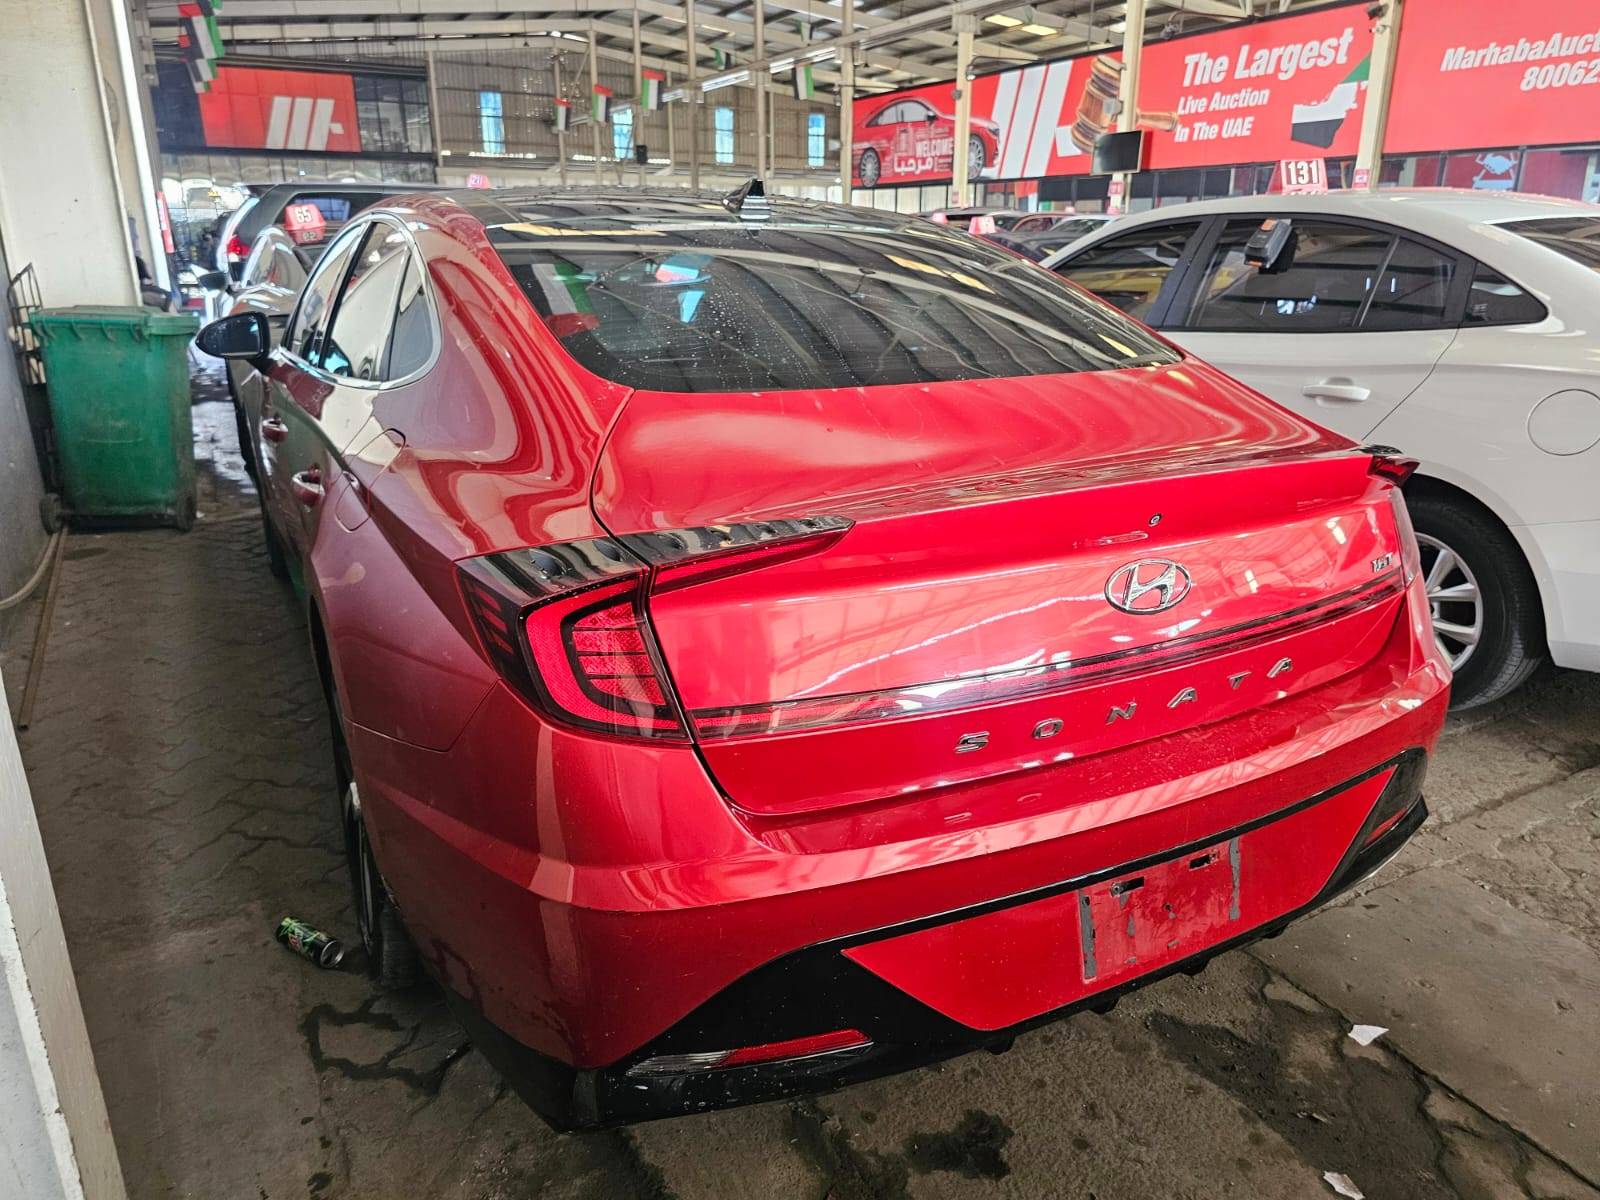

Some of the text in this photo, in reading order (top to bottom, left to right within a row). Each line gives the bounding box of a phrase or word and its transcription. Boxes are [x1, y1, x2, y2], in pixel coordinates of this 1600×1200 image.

[1183, 27, 1355, 87] The Largest
[1177, 88, 1270, 116] Live Auction
[1174, 116, 1255, 143] In The UAE
[915, 137, 954, 158] WELCOME
[893, 155, 934, 176] مرحبا
[1287, 159, 1319, 186] 131
[294, 206, 313, 224] 65
[954, 655, 1294, 755] SONATA
